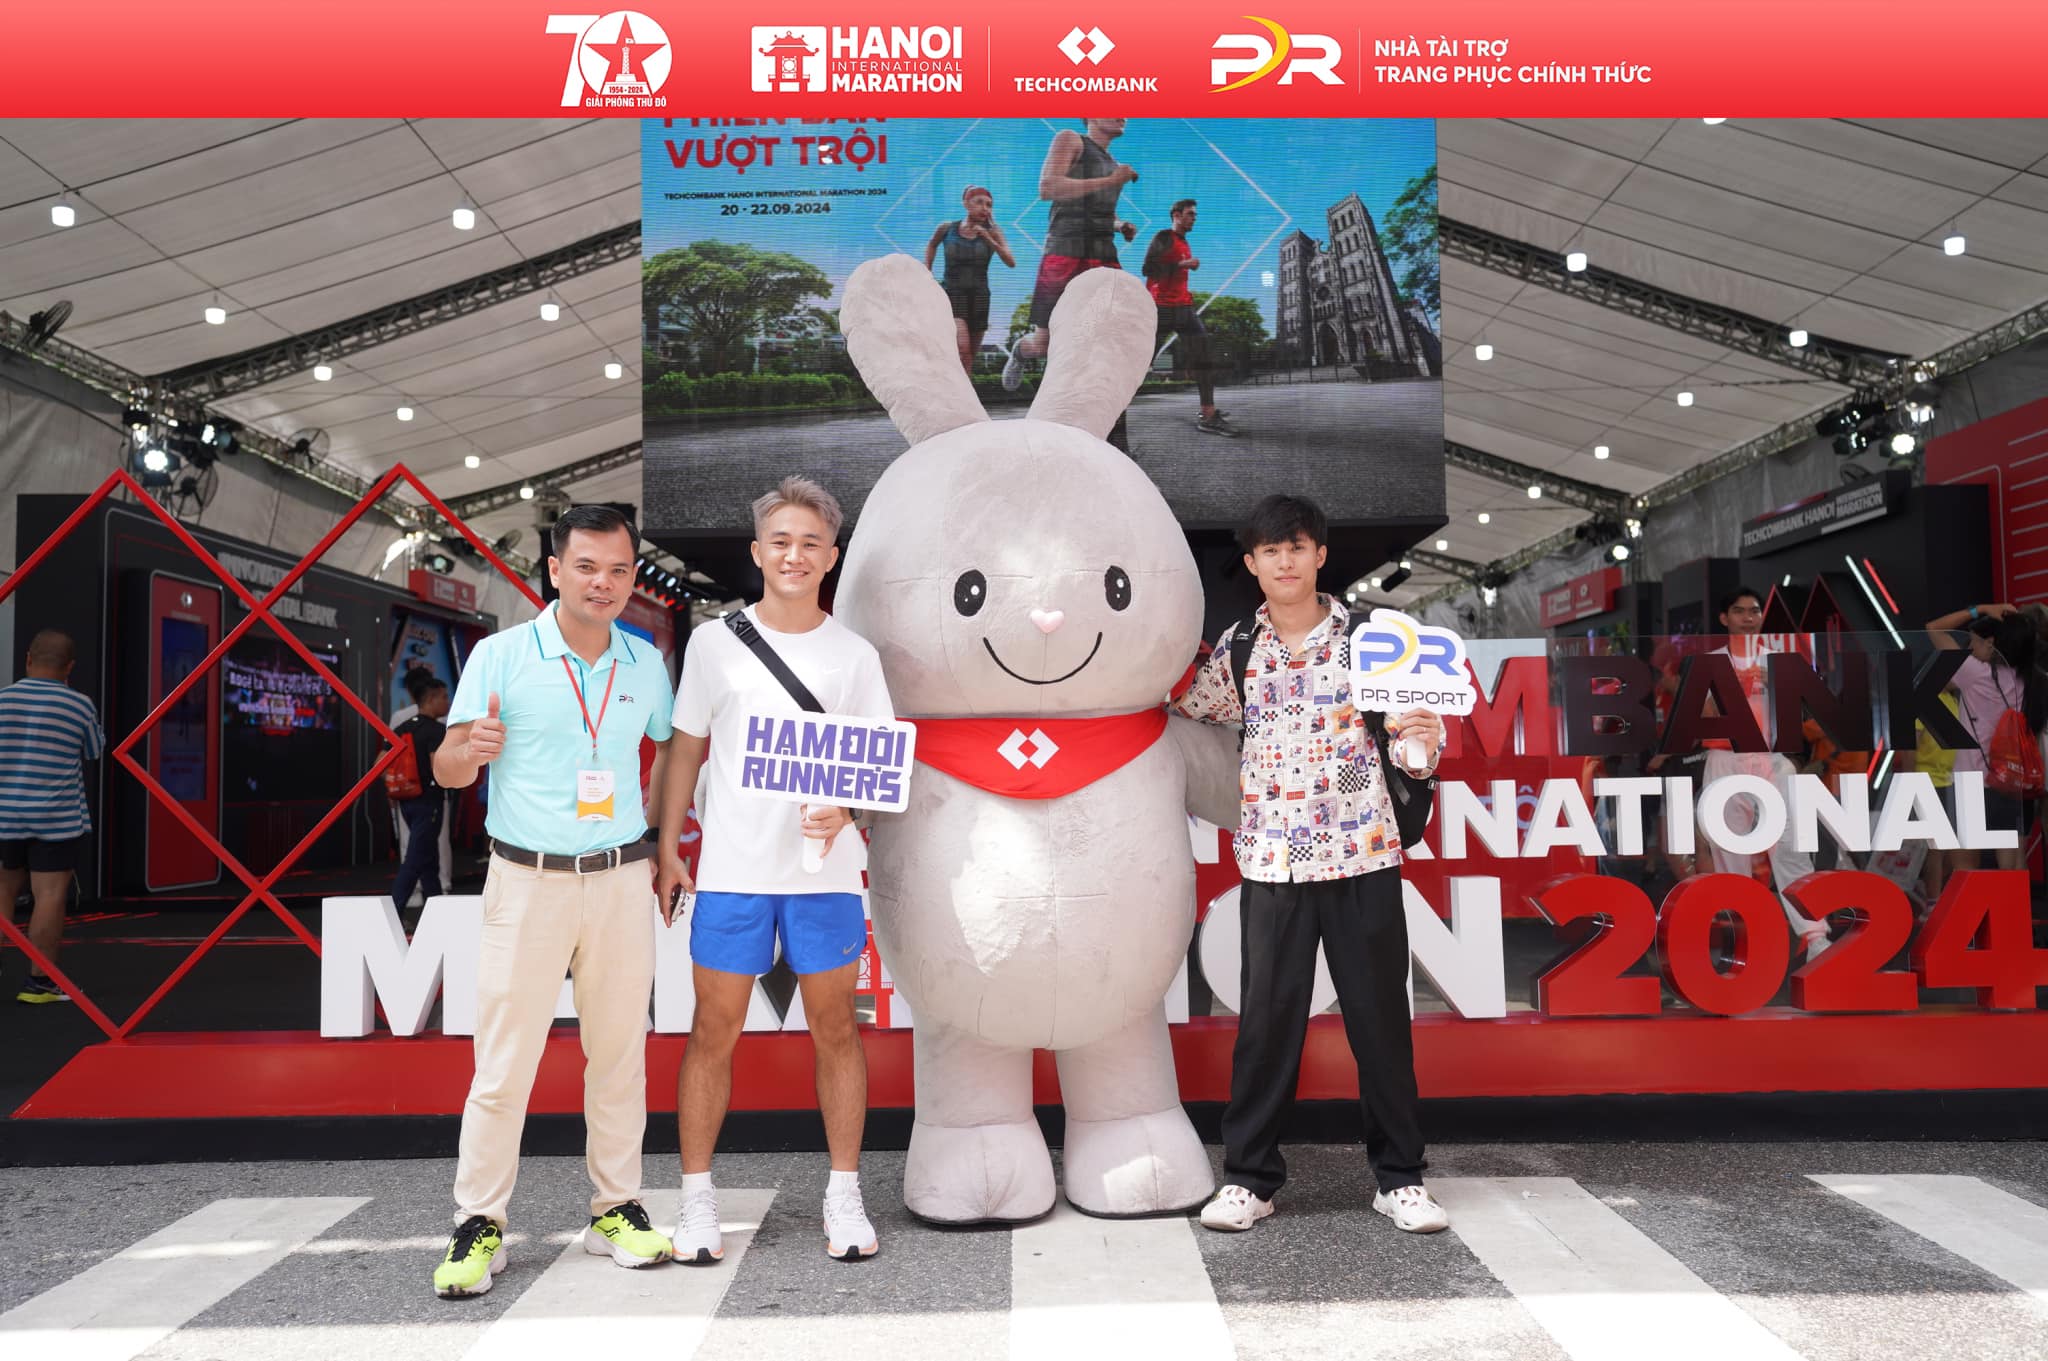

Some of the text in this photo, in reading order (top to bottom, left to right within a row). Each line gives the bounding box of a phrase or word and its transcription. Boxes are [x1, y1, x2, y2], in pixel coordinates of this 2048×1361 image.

[664, 127, 888, 175] VƯỢT TRỘI
[664, 188, 888, 201] TECHCOMBANK HANOI INTERNATIONAL MARATHON 2024
[720, 204, 739, 216] 20
[750, 202, 832, 215] 22.09.2024
[1743, 501, 1836, 547] TECHCOMBANK HANOI
[1359, 624, 1461, 676] PR
[1361, 688, 1468, 706] PR SPORT
[741, 755, 902, 804] RUNNERS
[1530, 869, 2048, 1018] 2024
